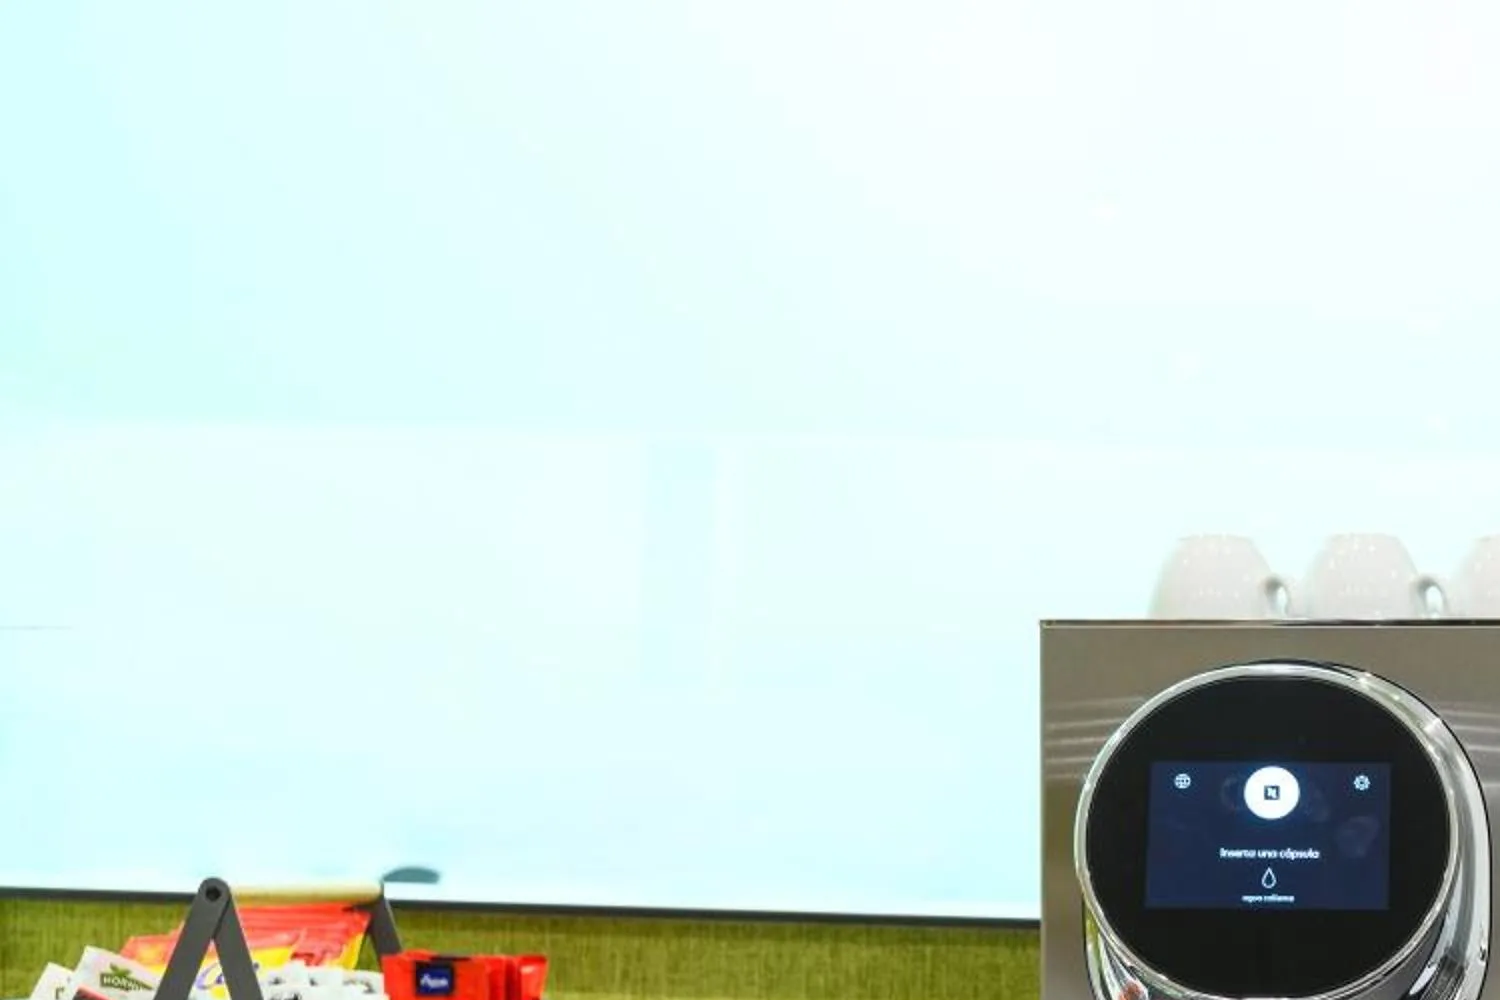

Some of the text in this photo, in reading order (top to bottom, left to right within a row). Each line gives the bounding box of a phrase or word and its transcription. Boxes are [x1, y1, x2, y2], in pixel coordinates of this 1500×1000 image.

[1219, 847, 1321, 860] Inserta una cápsula
